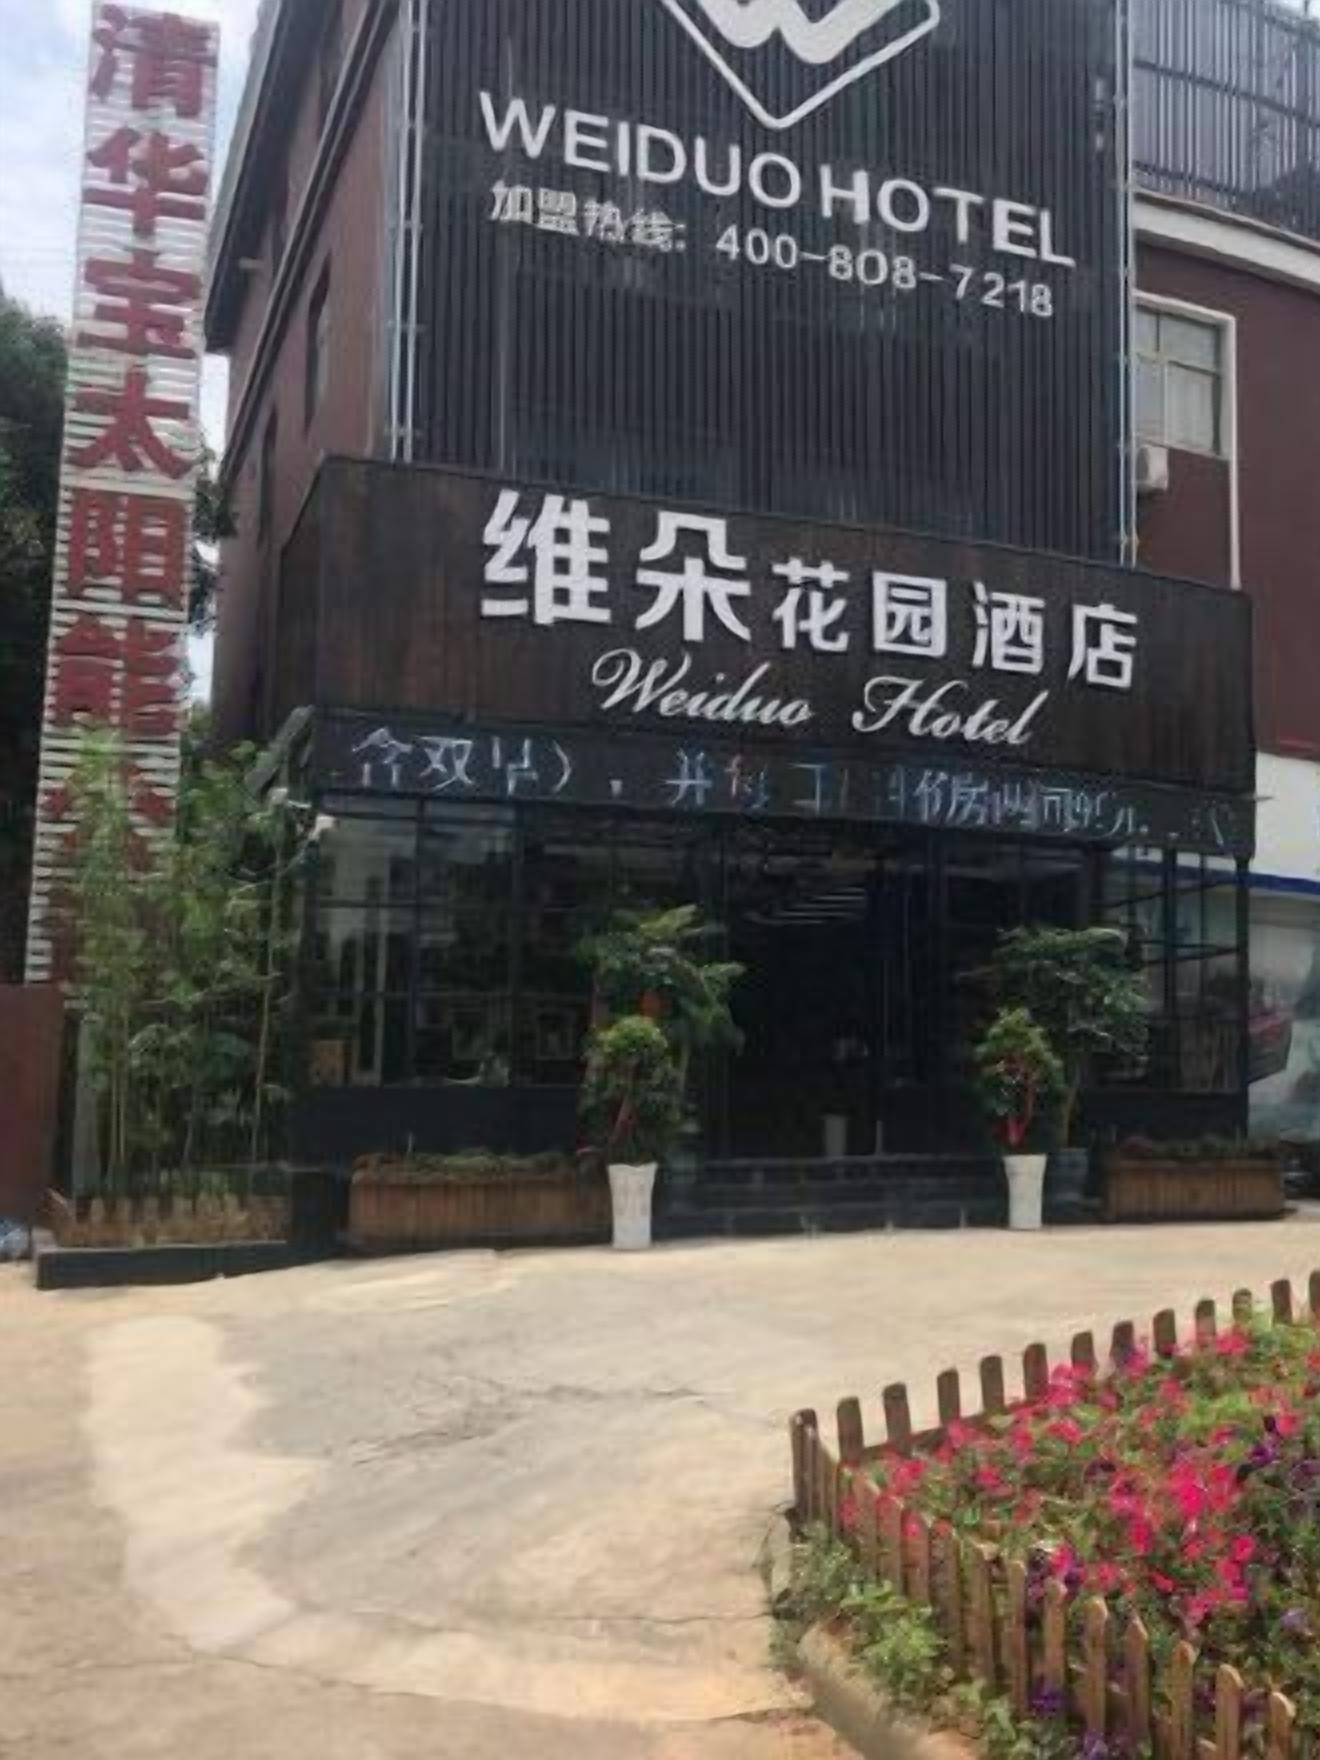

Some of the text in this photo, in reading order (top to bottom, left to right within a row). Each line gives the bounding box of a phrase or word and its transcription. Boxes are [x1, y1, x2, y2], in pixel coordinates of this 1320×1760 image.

[480, 91, 1076, 268] WEIDUO HOTEL
[715, 223, 1054, 319] 400-808-7218
[480, 489, 1139, 691] 维朵花园酒店
[591, 648, 1050, 747] Weiduo Hotel
